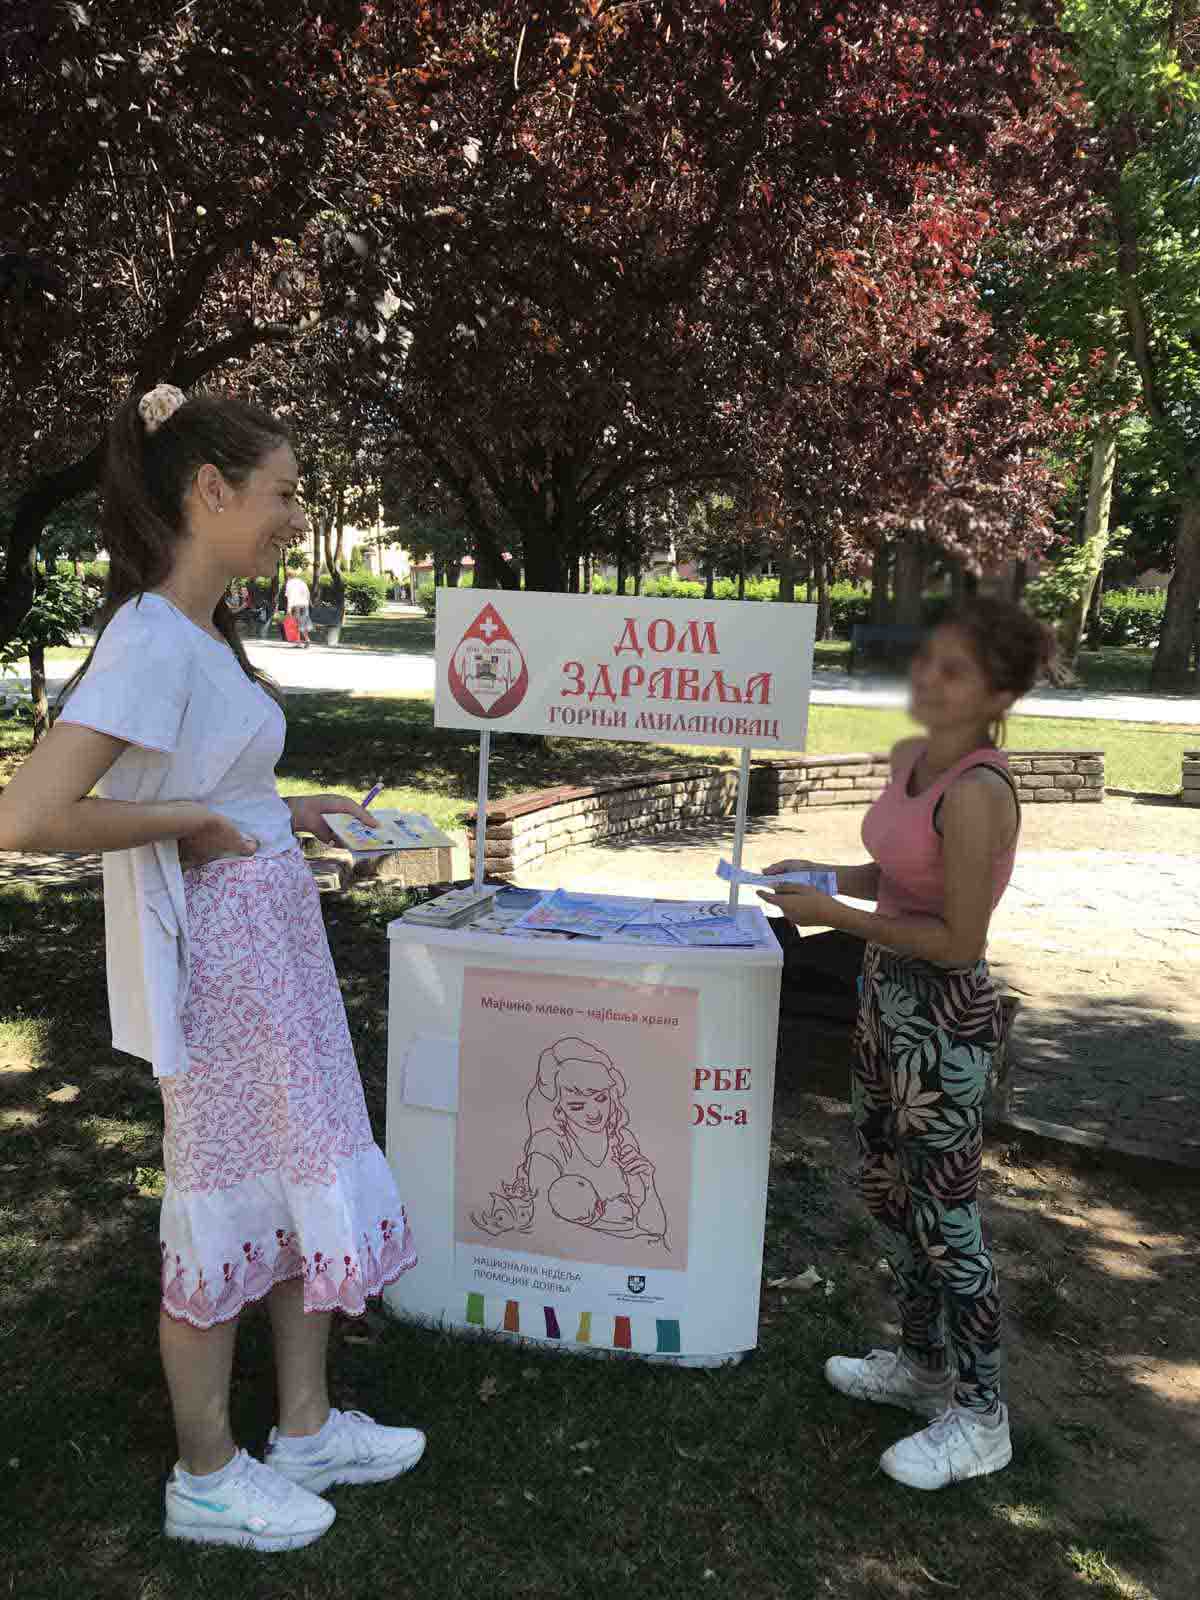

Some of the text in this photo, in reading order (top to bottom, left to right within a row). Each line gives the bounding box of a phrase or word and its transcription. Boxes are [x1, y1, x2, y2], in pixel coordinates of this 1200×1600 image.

[613, 617, 720, 657] ДОМ
[560, 660, 774, 705] ЗДРАВЉА
[549, 705, 779, 740] ГОРЊИ МИЛАНОВАЦ
[536, 1003, 574, 1016] млеко
